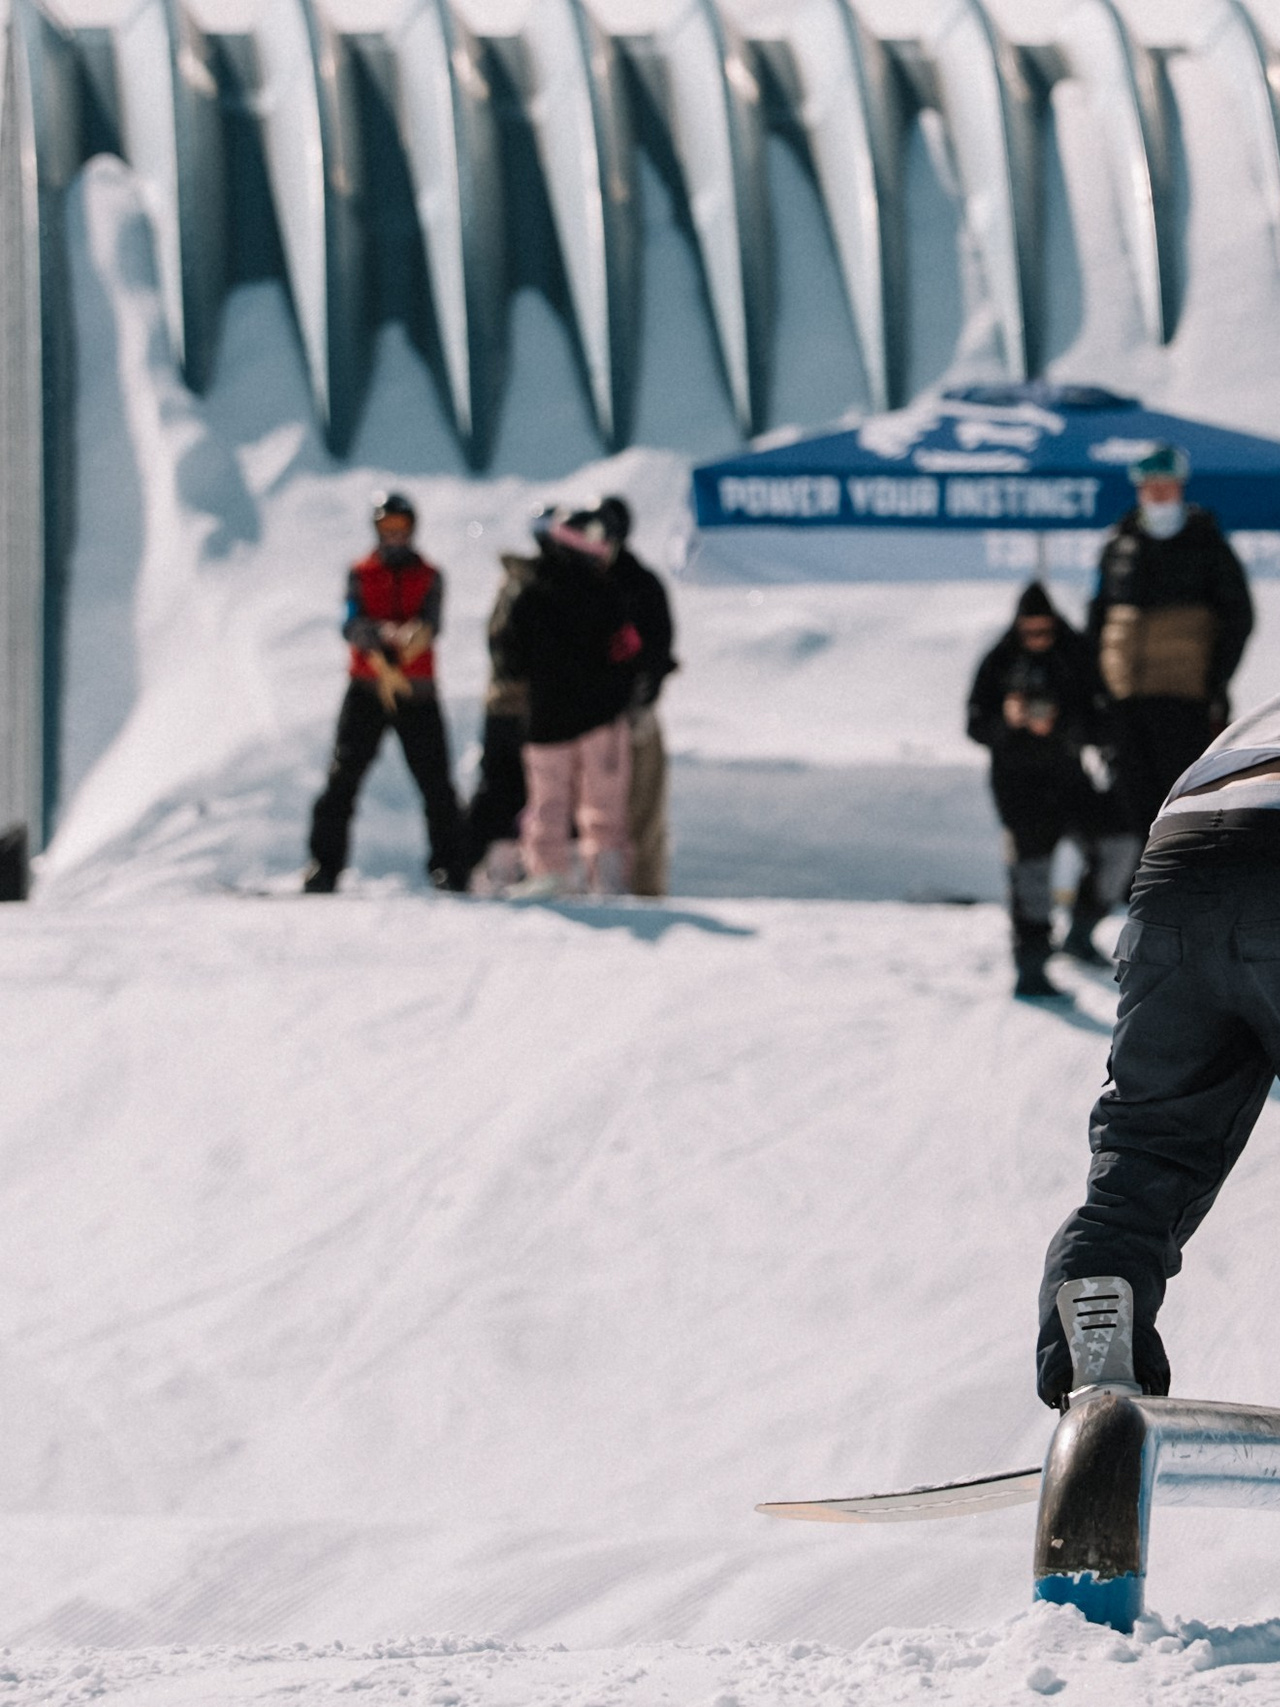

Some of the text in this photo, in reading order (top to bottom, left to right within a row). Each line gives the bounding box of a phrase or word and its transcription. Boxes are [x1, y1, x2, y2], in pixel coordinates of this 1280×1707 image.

[719, 476, 1098, 518] POWER YOUR INSTINCT
